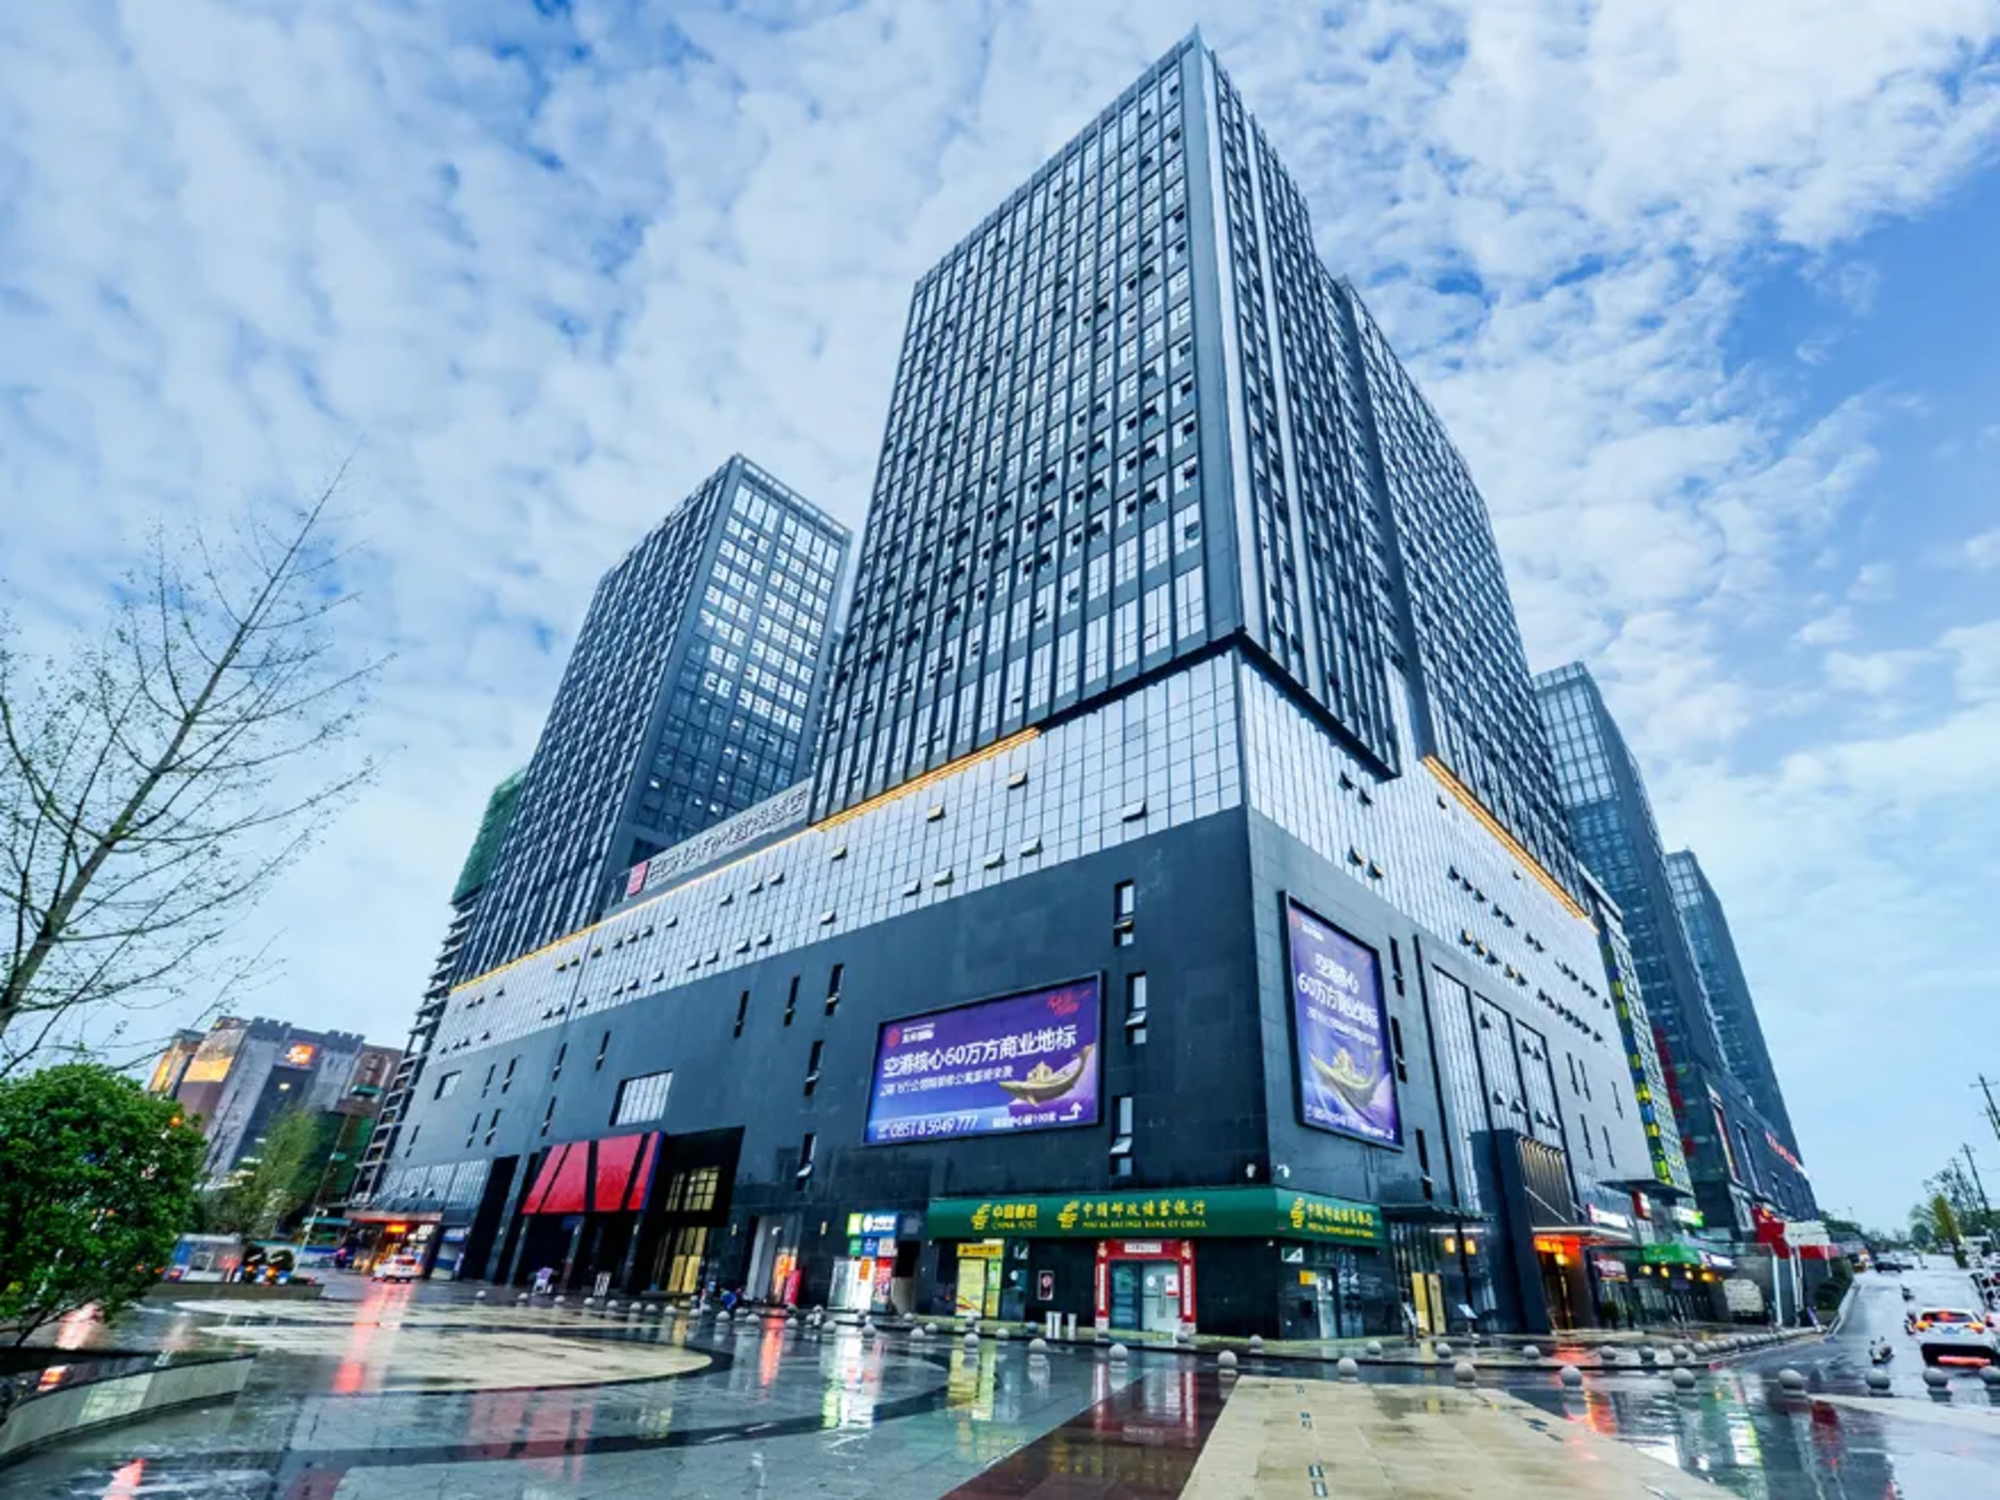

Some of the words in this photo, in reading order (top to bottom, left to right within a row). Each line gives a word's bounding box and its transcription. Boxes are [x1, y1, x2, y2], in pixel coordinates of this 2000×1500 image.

[883, 1024, 1077, 1078] 空港核心60万方商业地标
[1082, 1199, 1206, 1219] 中国邮政储蓄银行
